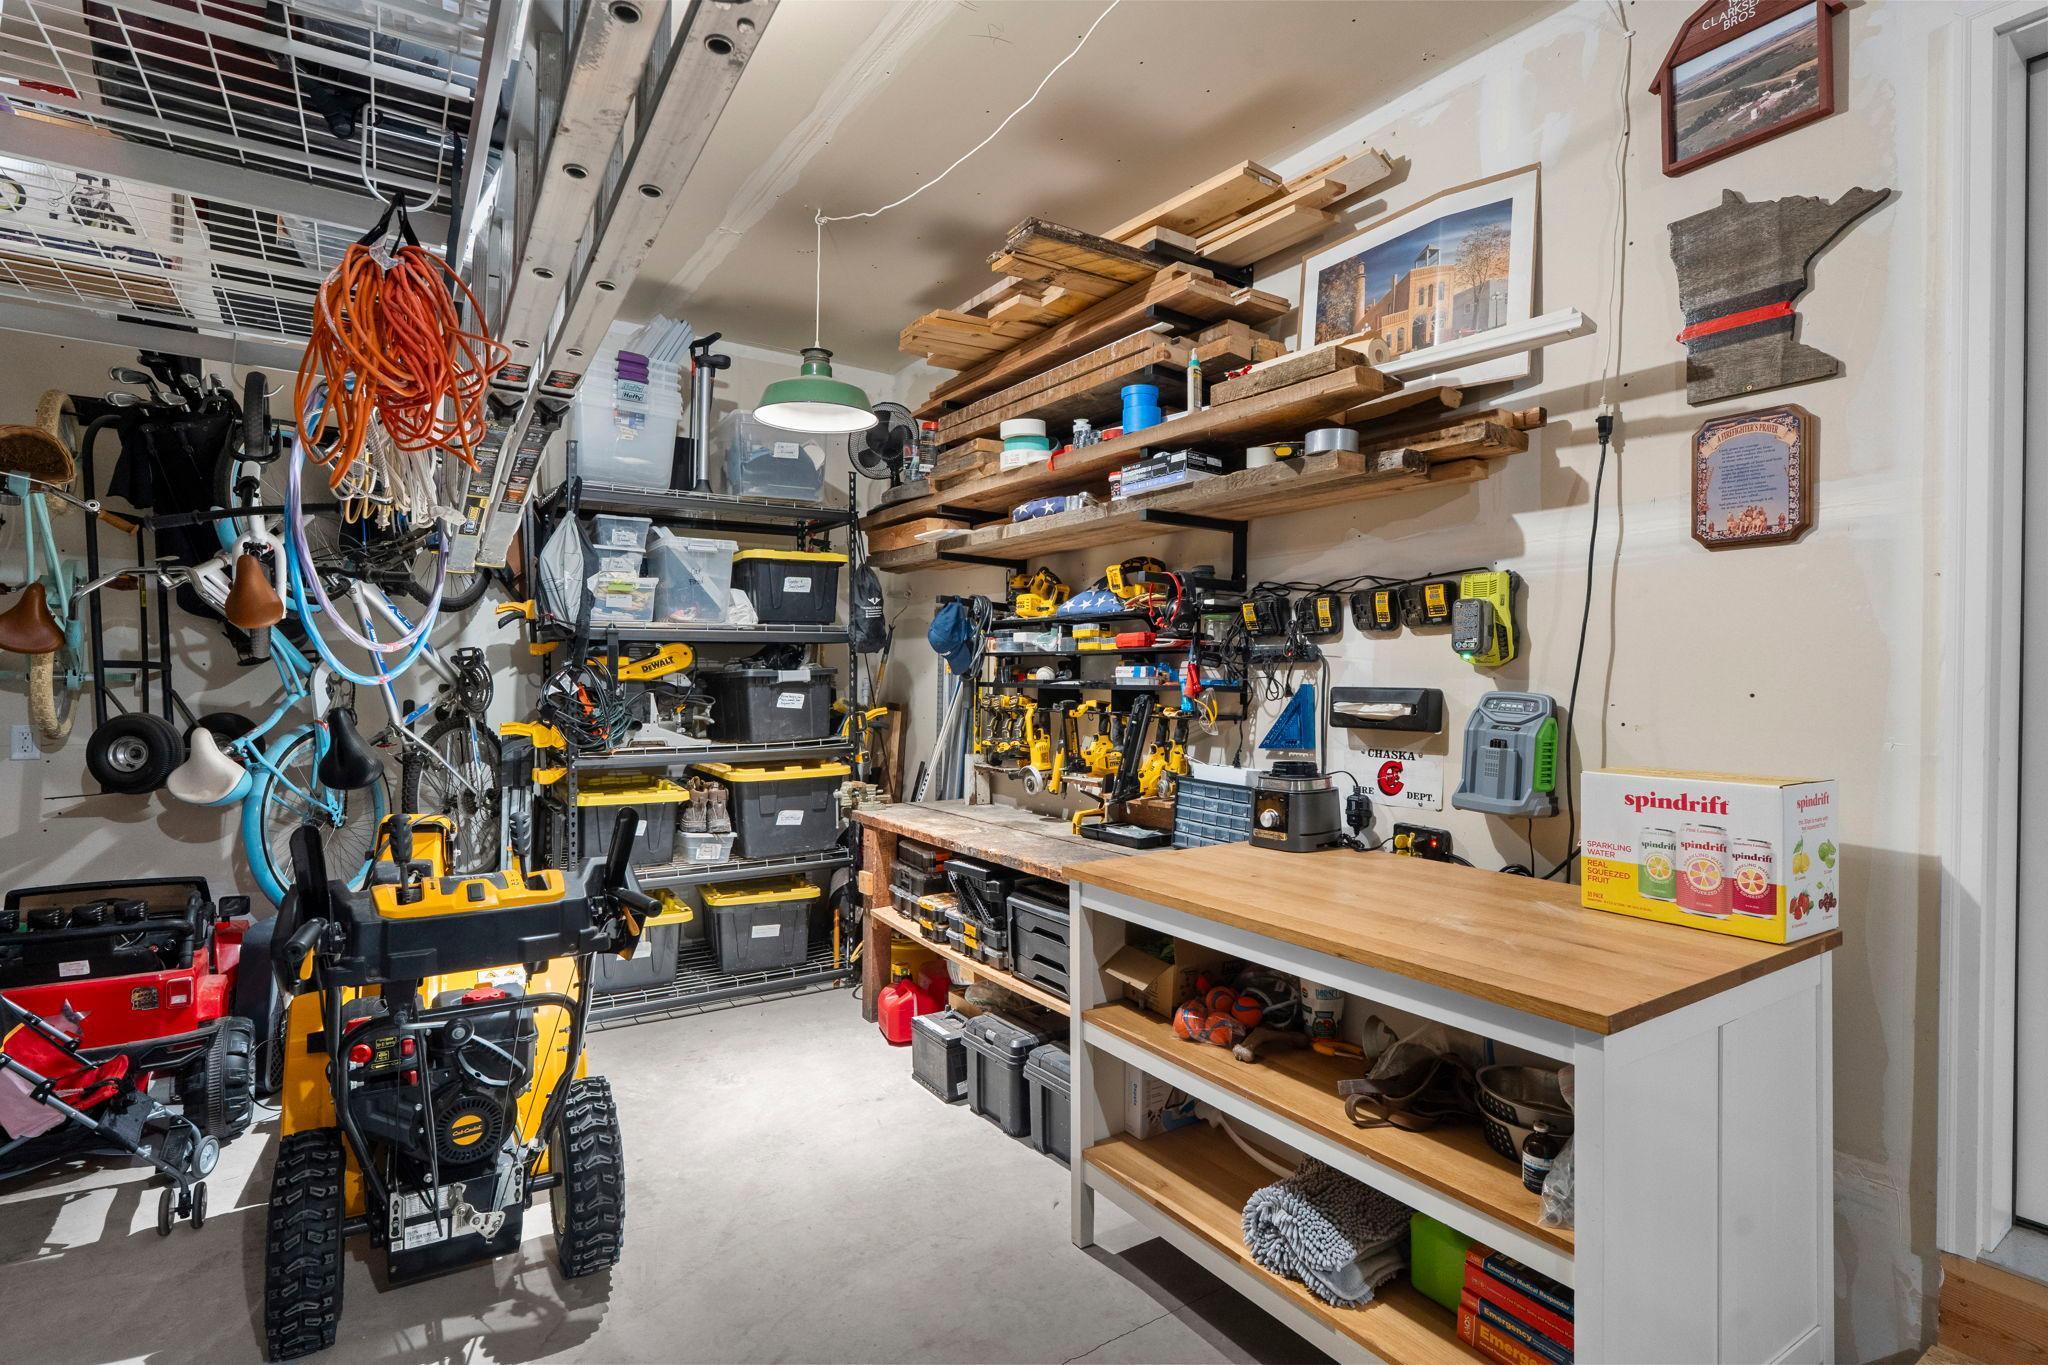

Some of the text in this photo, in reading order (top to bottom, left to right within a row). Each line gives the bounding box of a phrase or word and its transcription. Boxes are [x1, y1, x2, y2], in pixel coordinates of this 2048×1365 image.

[1702, 0, 1760, 30] CLARKSE
[1723, 8, 1756, 30] BROS
[623, 391, 642, 401] Hefty
[1759, 422, 1779, 433] PRAYER
[1367, 748, 1416, 761] CHASKA
[1406, 791, 1435, 802] DEPT.
[1624, 791, 1728, 815] spindrift
[1796, 791, 1830, 813] spindrift
[1586, 840, 1632, 853] SPARKLING
[1680, 840, 1728, 853] spindrift
[1586, 849, 1616, 859] WATER
[1731, 852, 1773, 863] spindrift
[1586, 859, 1609, 869] REAL
[1586, 867, 1631, 880] SQUEEZED
[1586, 875, 1610, 885] FRUIT
[1487, 1262, 1570, 1310] Emergency Medical Responder
[1484, 1307, 1532, 1342] Emergency
